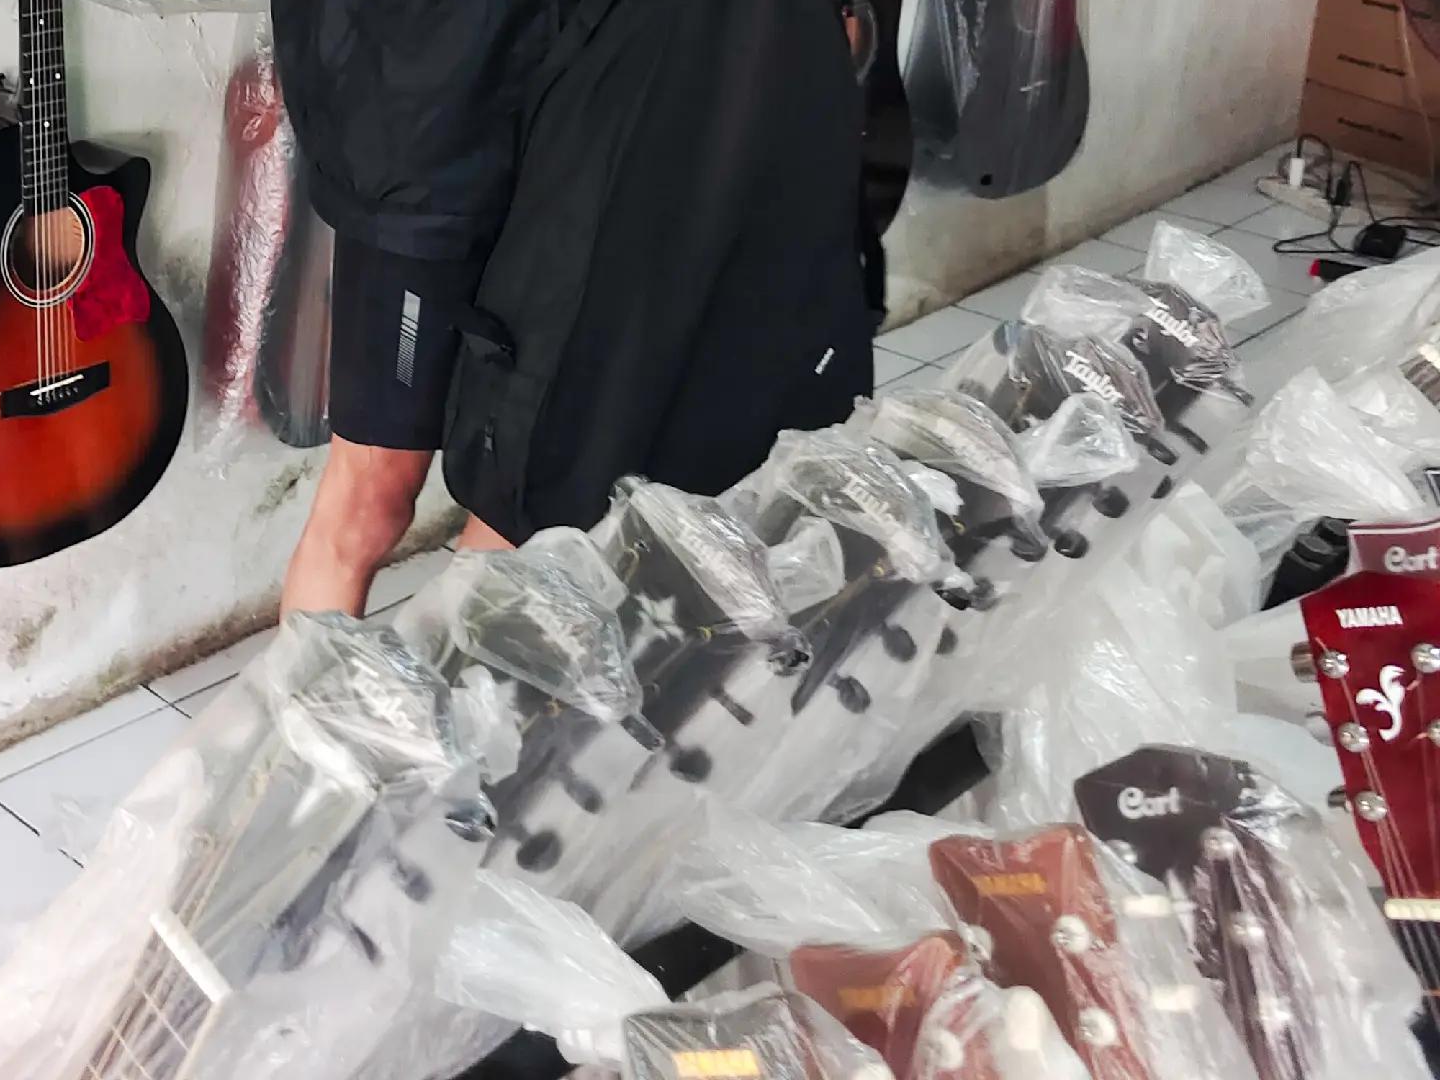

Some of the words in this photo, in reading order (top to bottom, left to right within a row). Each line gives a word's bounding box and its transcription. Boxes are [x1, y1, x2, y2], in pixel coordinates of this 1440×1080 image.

[1143, 296, 1201, 348] Taylor
[1063, 350, 1125, 402] Taylor
[1384, 546, 1438, 572] Cort
[1335, 605, 1403, 629] YAMAHA
[1117, 787, 1182, 820] Cort
